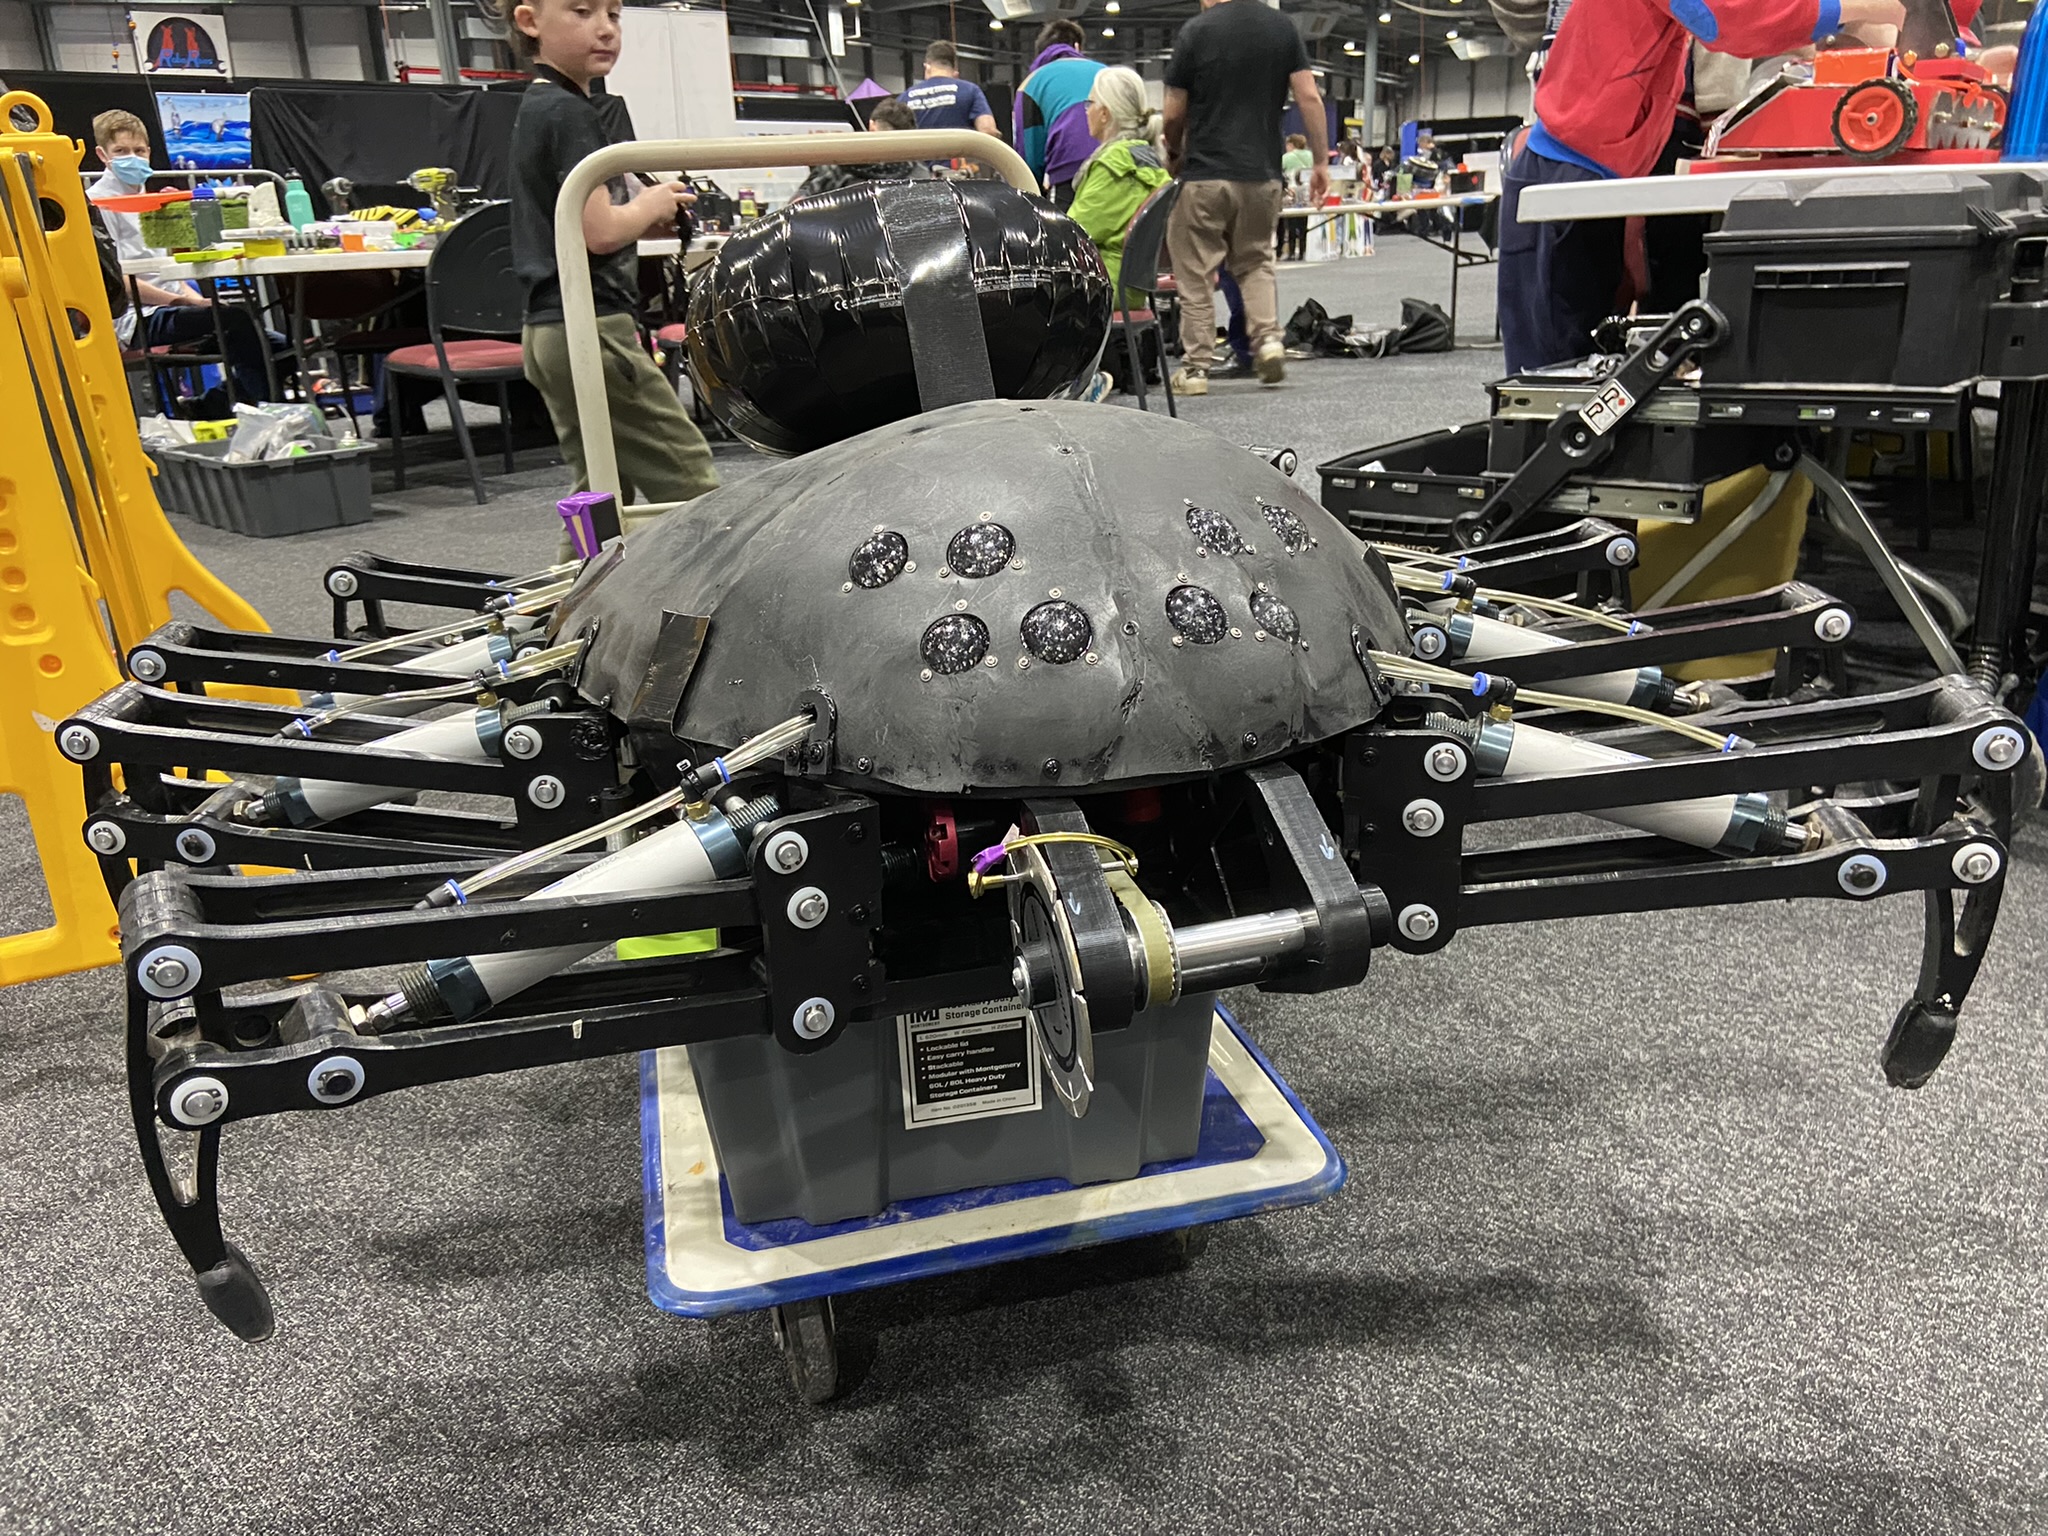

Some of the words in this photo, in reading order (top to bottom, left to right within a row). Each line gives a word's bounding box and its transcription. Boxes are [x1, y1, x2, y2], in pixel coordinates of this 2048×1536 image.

[945, 1009, 981, 1020] Storage
[926, 1042, 959, 1052] Lockable
[927, 1053, 945, 1061] Easy
[945, 1051, 965, 1059] carry
[966, 1046, 995, 1055] handles
[927, 1061, 964, 1071] Stackable
[928, 1071, 958, 1080] Modular
[975, 1061, 1021, 1073] Montgomery
[965, 1076, 988, 1084] Heavy
[988, 1073, 1006, 1081] Duty
[929, 1090, 958, 1099] Storage
[959, 1084, 998, 1095] Containers
